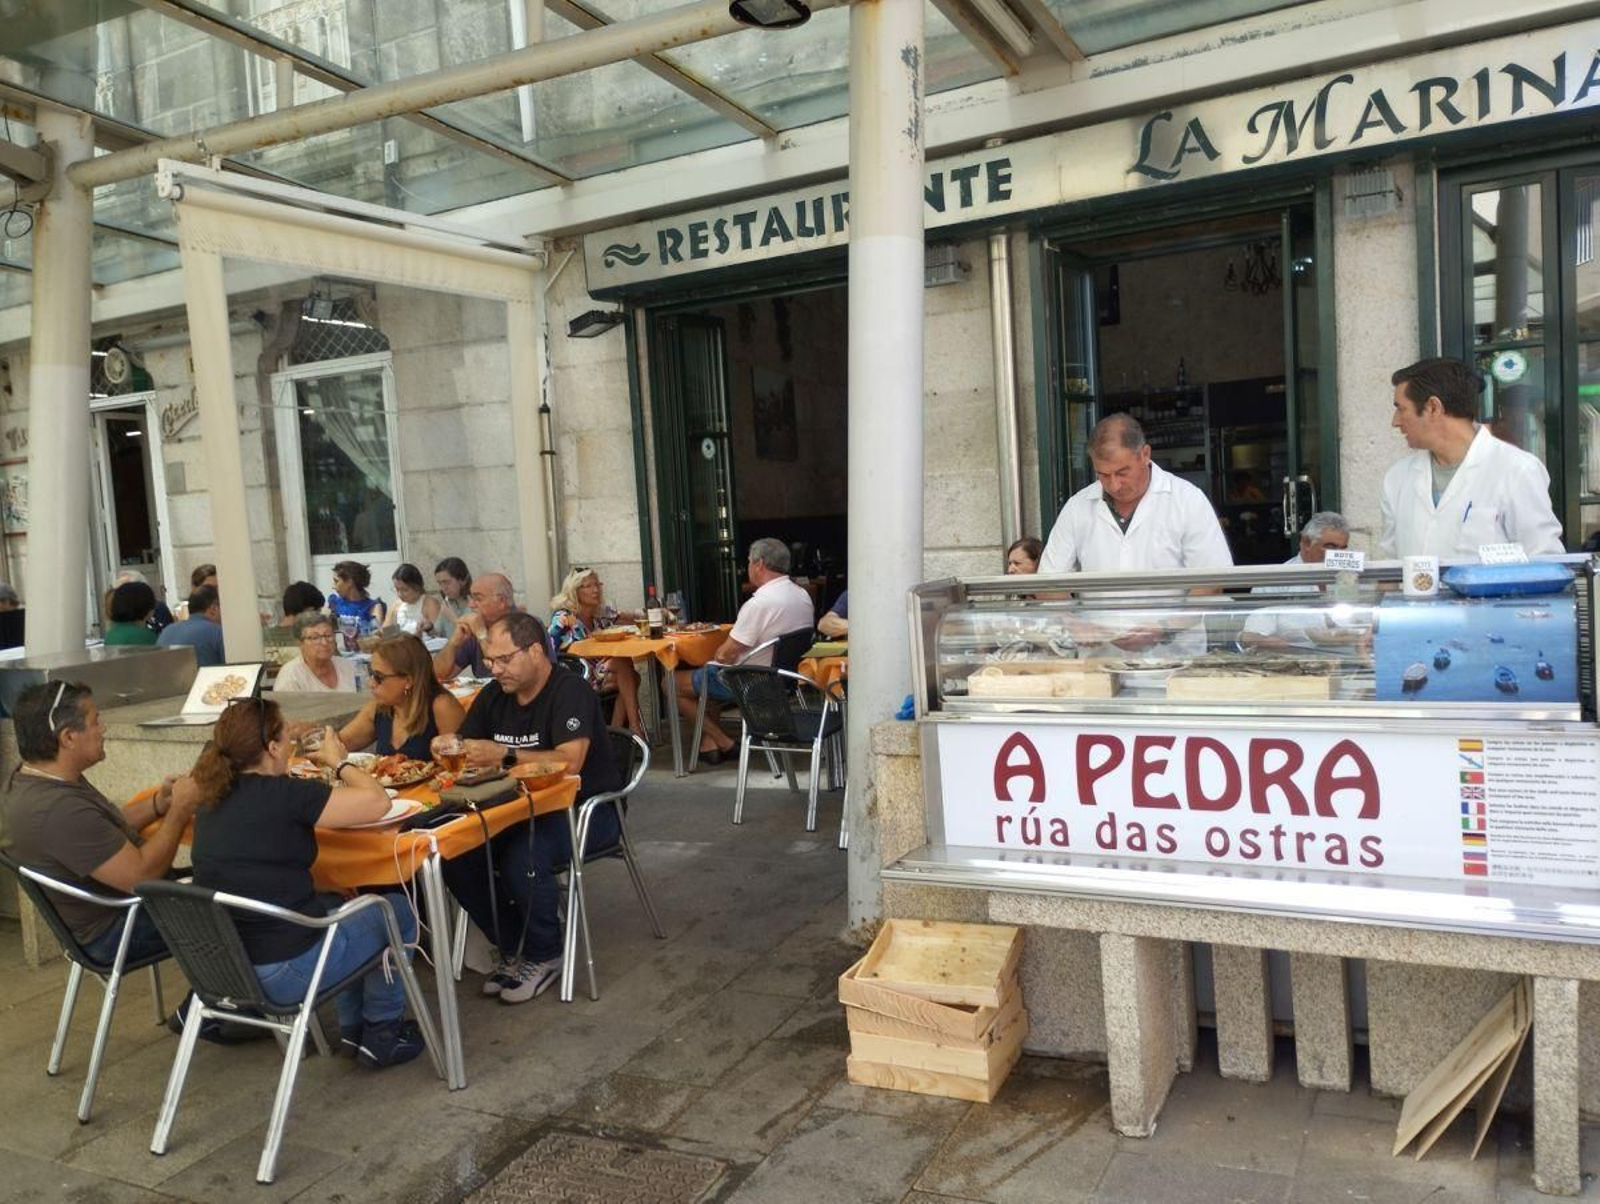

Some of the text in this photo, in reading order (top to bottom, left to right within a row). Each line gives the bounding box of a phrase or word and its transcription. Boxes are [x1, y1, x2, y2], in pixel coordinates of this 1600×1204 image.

[657, 158, 1012, 266] RESTAURNTE
[1127, 111, 1222, 180] LA
[994, 731, 1380, 820] A PEDRA
[996, 806, 1384, 868] rúa das ostras
